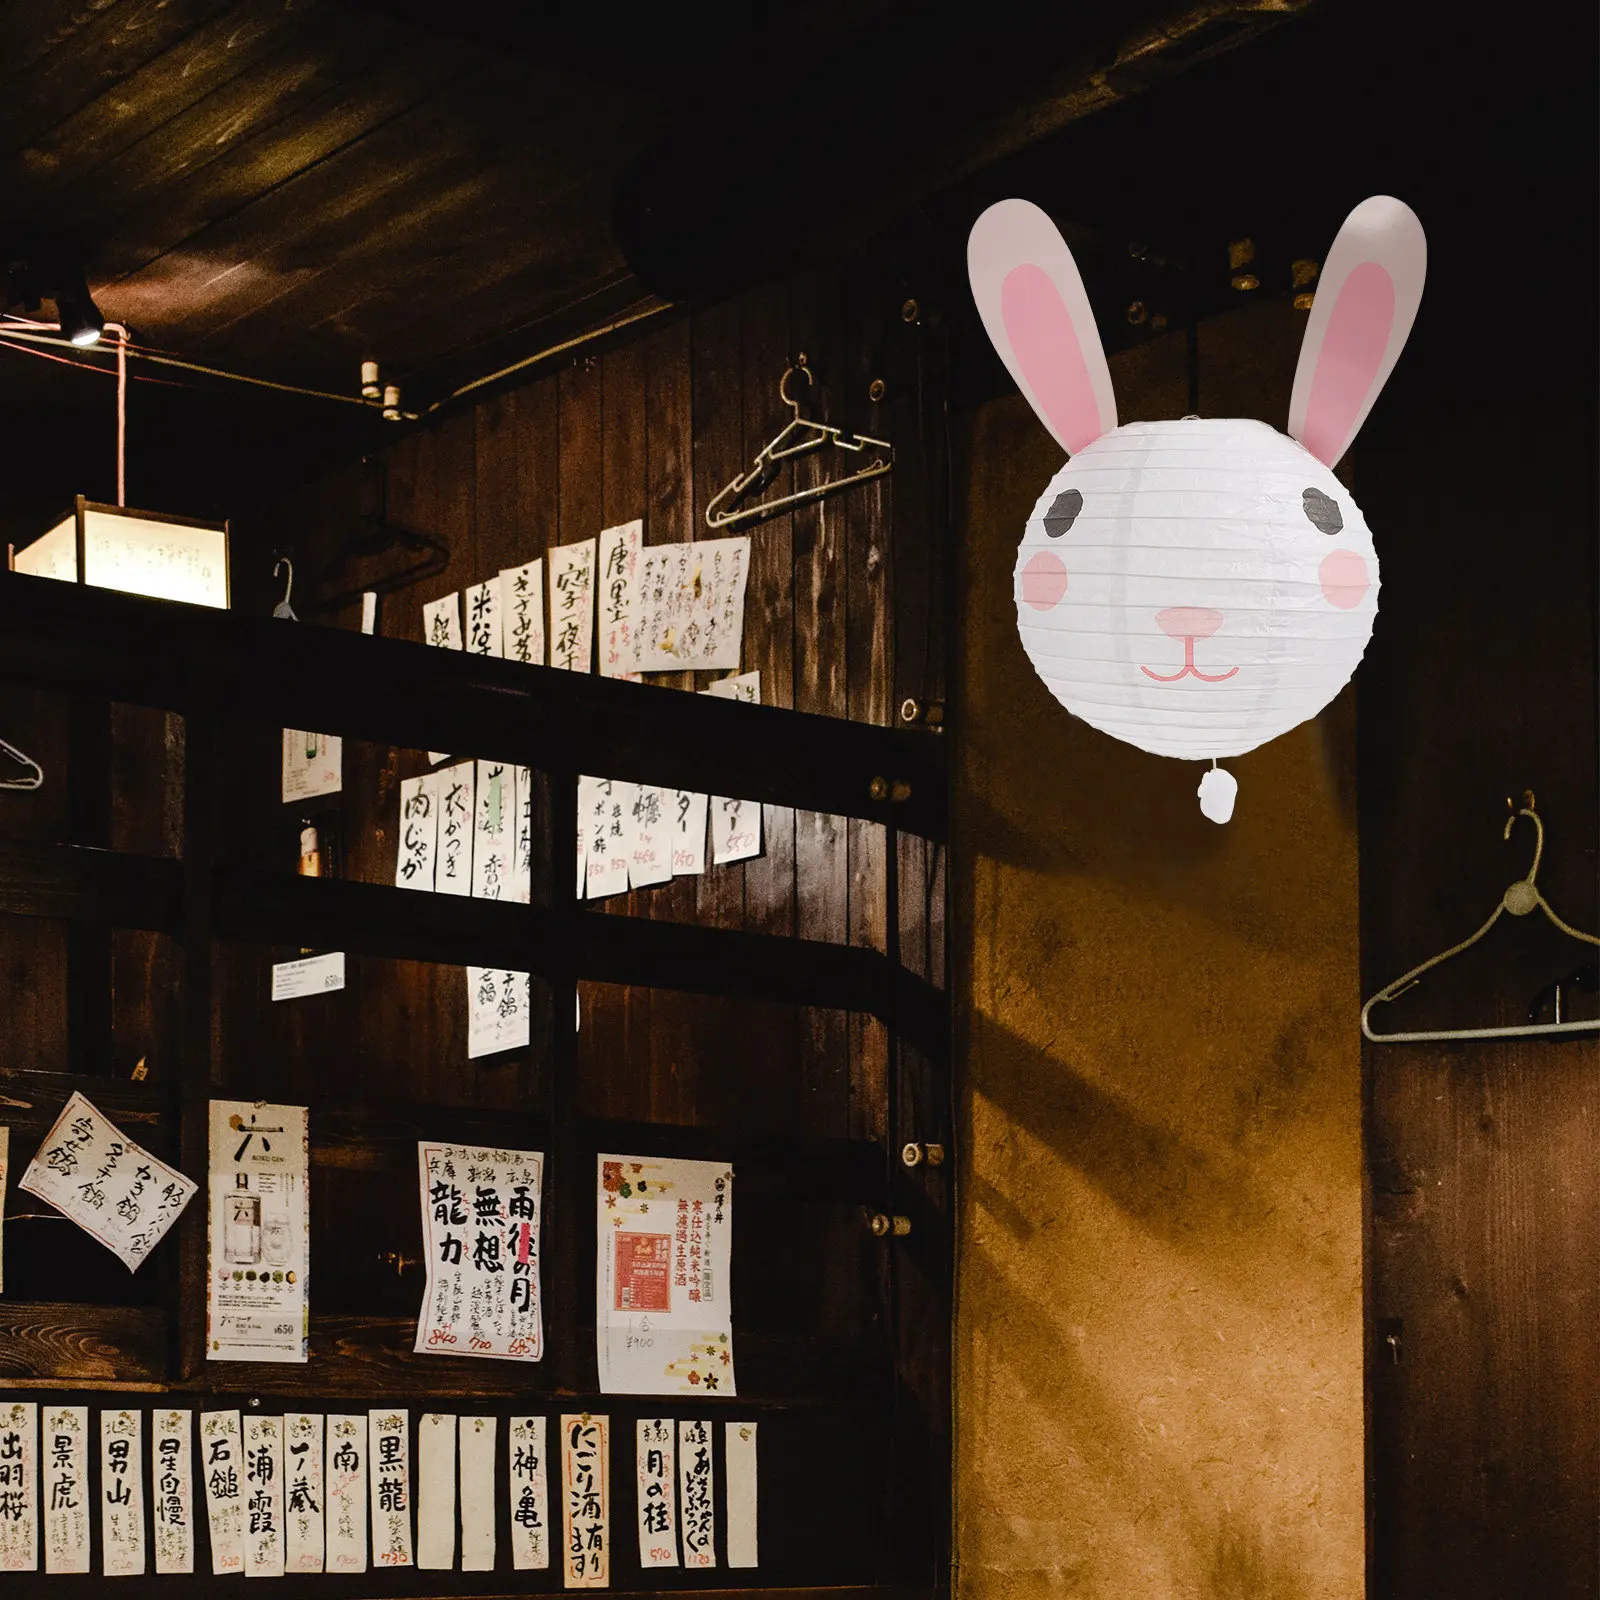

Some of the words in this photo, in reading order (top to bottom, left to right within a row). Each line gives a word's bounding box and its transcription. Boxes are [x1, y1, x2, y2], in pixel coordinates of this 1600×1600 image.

[401, 780, 430, 880] 肉じゃが
[445, 783, 466, 878] 衣かつぎ
[726, 832, 756, 854] 550
[233, 1113, 284, 1162] 六
[505, 1168, 535, 1185] 広島
[430, 1180, 468, 1265] 龍力
[472, 1185, 505, 1273] 無想
[274, 1324, 294, 1335] ¥650
[428, 1328, 458, 1345] 840
[468, 1335, 492, 1350] 700
[333, 1442, 360, 1473] 南
[643, 1426, 669, 1444] 京都
[685, 1427, 708, 1444] 岐阜
[0, 1431, 28, 1521] 出羽桜
[51, 1435, 79, 1511] 景虎
[106, 1439, 131, 1506] 男山
[156, 1438, 185, 1526] 星自慢
[209, 1439, 240, 1500] 石鎚
[248, 1444, 277, 1535] 浦霞
[288, 1442, 320, 1513] 一ノ蔵
[378, 1436, 407, 1513] 黒龍
[512, 1445, 543, 1528] 神亀
[646, 1449, 670, 1534] 月の桂
[220, 1555, 241, 1568] 520
[381, 1552, 408, 1565] 730
[650, 1547, 671, 1561] 570
[687, 1554, 710, 1565] 1120
